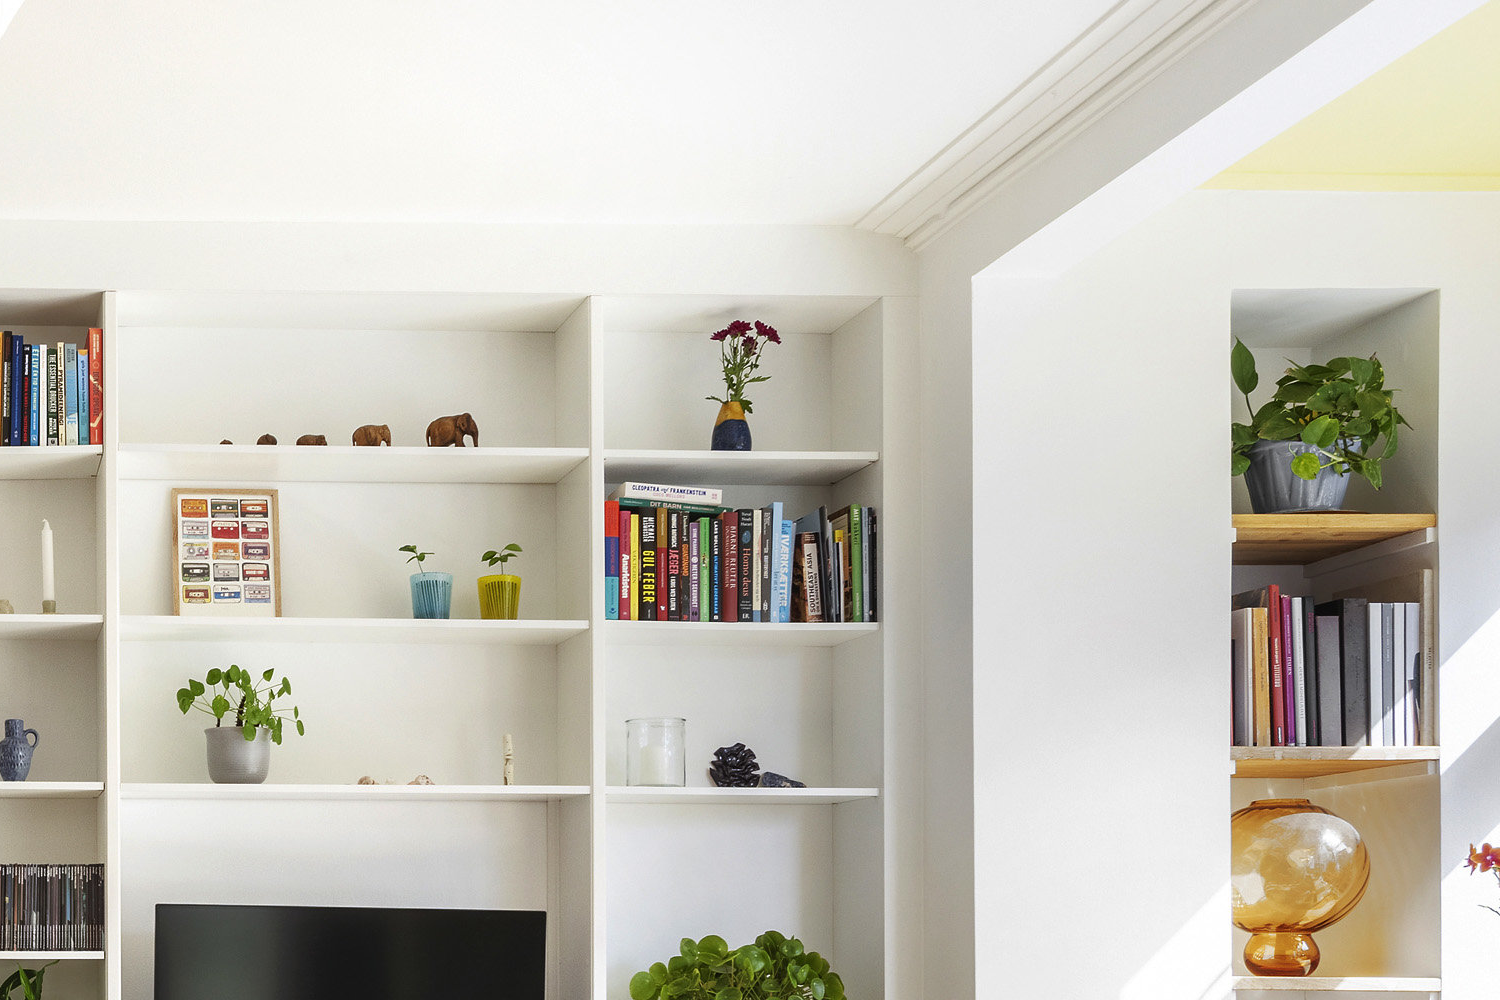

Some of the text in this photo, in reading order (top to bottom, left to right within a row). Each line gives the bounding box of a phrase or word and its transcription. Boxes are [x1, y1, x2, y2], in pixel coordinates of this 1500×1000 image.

[631, 484, 660, 493] CLEOPATRA
[669, 487, 707, 497] FRANKENSTEIN
[621, 553, 630, 599] Anarkisten
[643, 550, 655, 603] GUL FEBER
[669, 549, 679, 575] JÆGER
[729, 525, 737, 589] BJARNE REUTER
[742, 548, 751, 597] Homo deus
[780, 534, 790, 607] IVÆRKSÆTTER
[807, 571, 816, 613] SOUTHEAST
